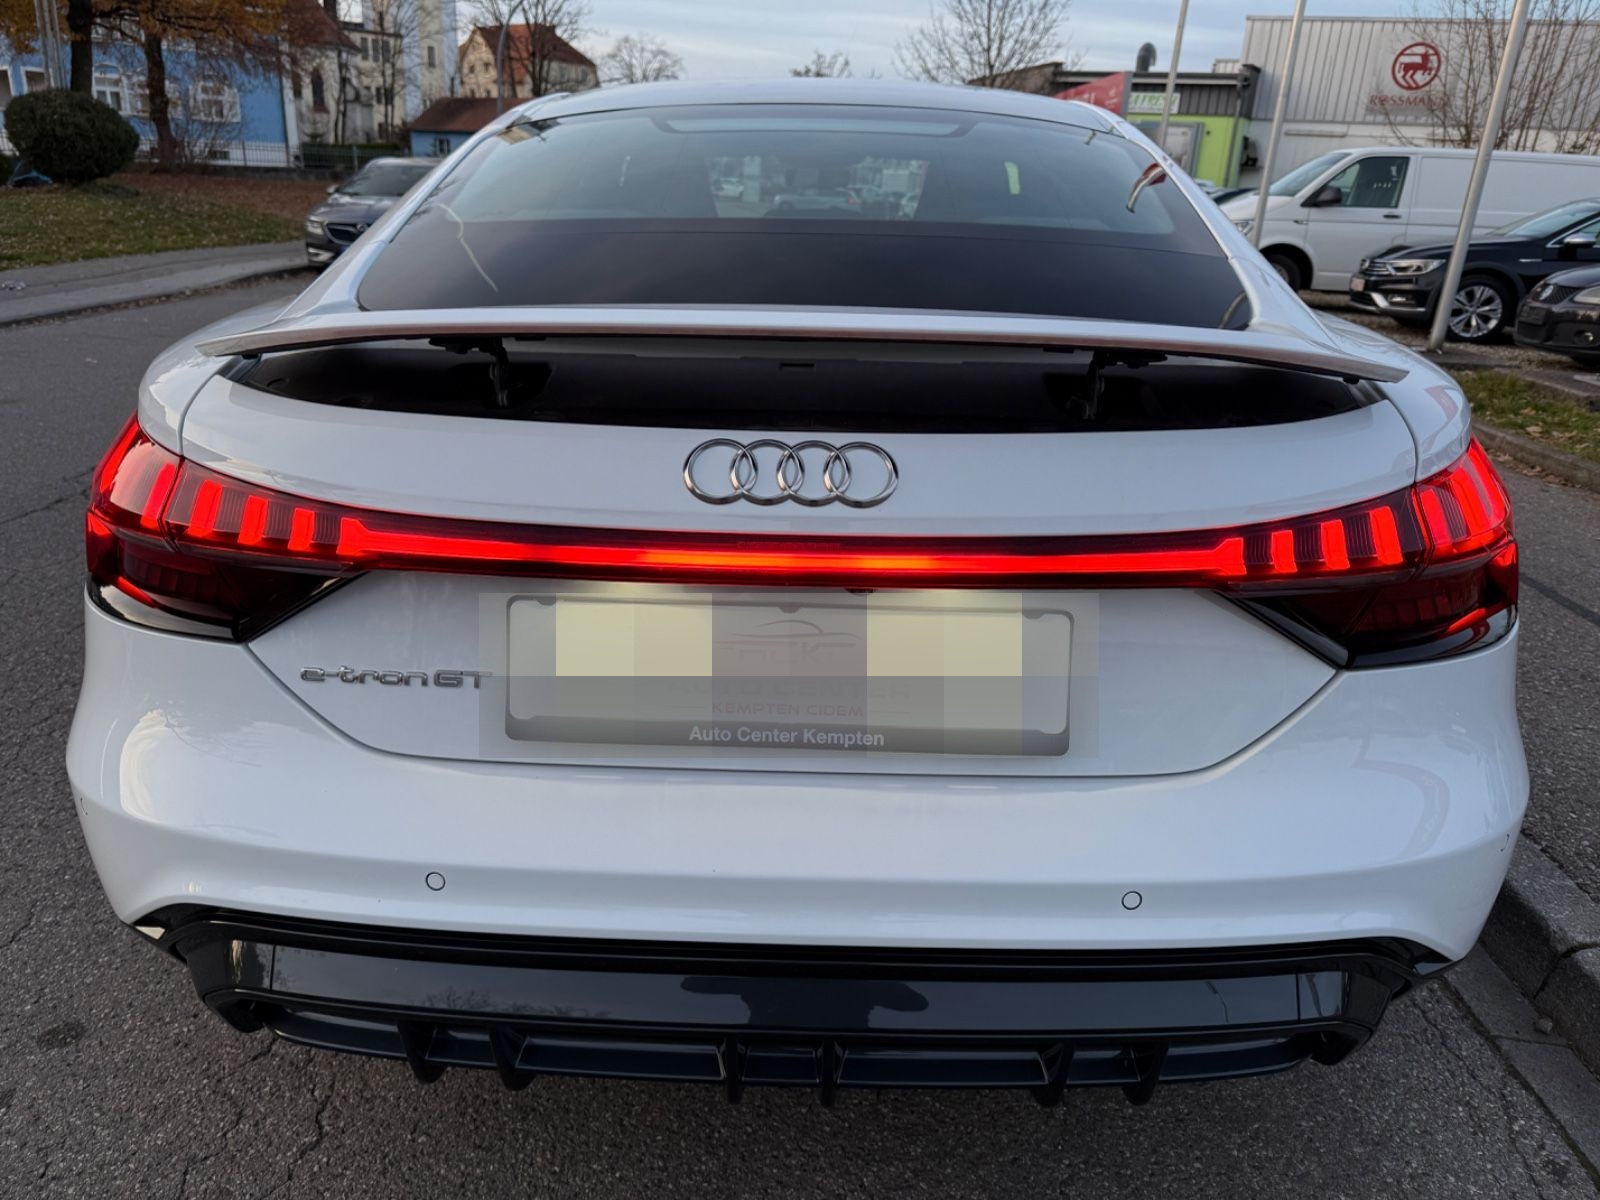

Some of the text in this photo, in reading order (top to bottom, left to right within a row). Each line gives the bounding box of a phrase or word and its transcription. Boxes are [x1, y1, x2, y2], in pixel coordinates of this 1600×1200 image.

[1370, 94, 1450, 108] ROSSMANN
[300, 665, 492, 689] e-tron GT
[712, 701, 864, 718] KEMPTEN CIDEM
[689, 725, 885, 748] Auto Center Kempten
